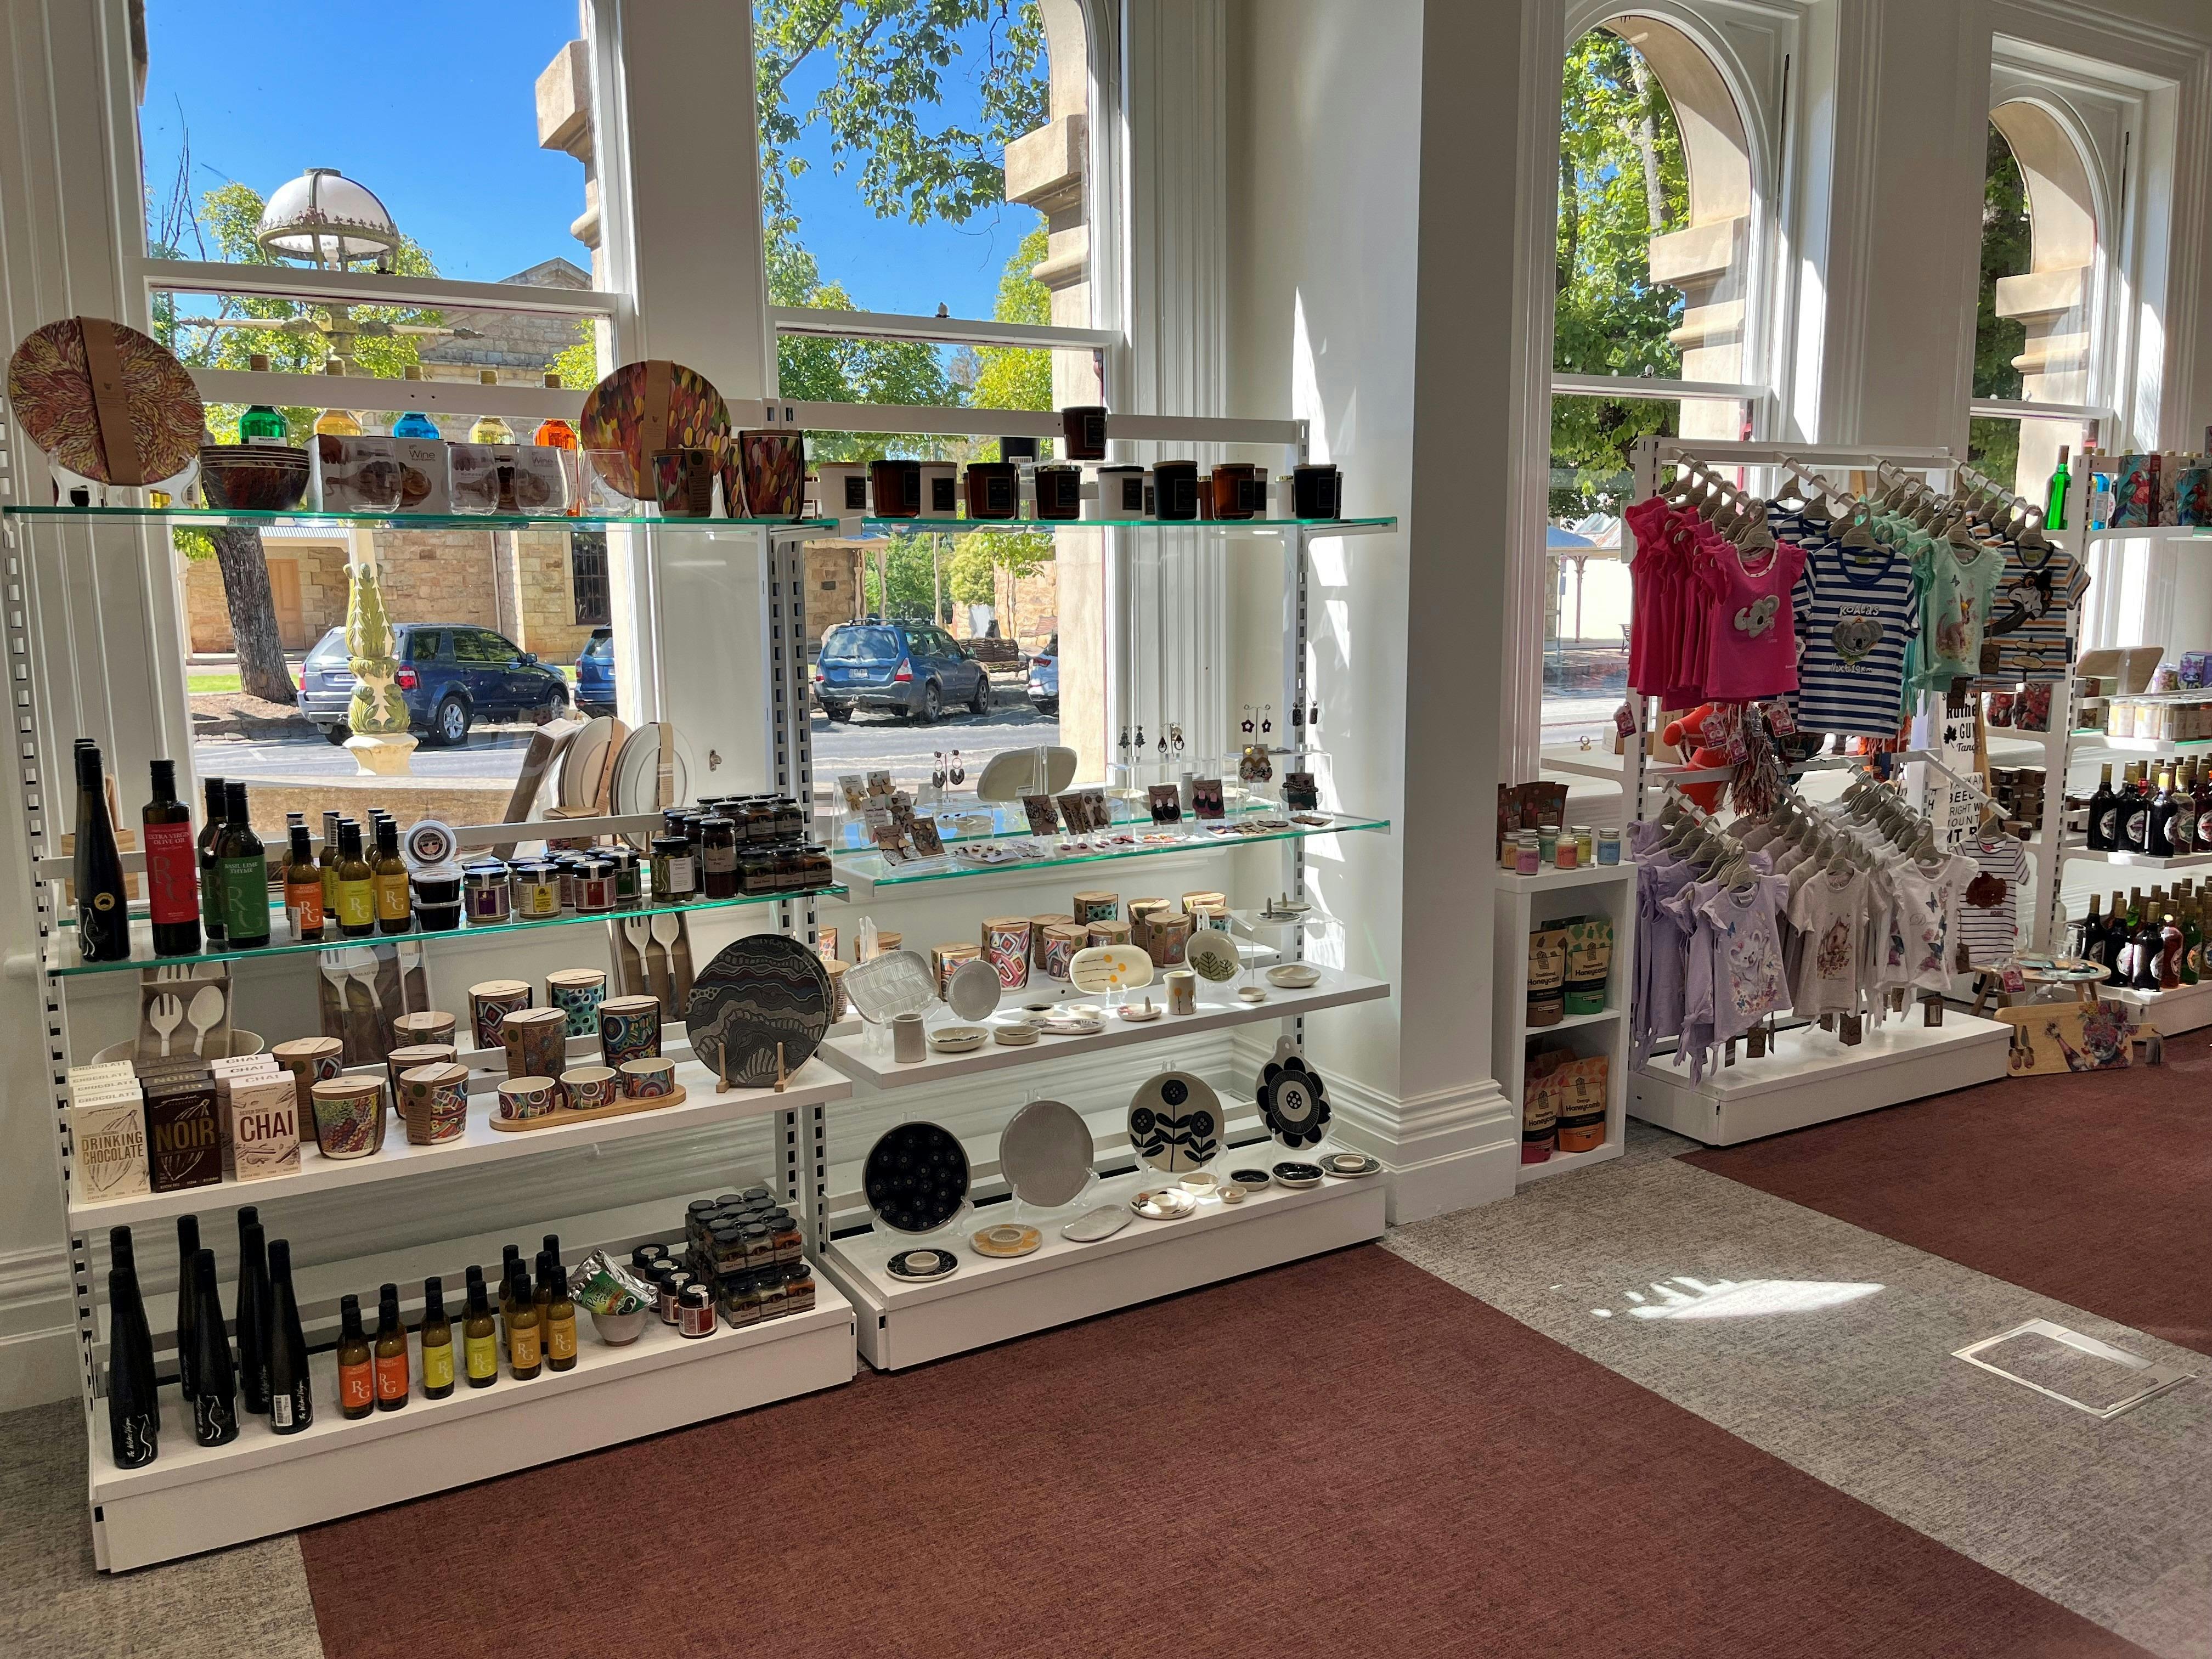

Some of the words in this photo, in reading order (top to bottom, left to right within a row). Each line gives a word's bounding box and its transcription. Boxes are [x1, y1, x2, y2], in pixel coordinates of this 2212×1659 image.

[532, 456, 553, 465] Wine
[1948, 814, 1979, 827] OUNT
[351, 898, 369, 918] RG
[386, 890, 404, 910] RG
[300, 901, 320, 922] RG
[72, 1062, 128, 1071] CHOCOLATE
[73, 1073, 127, 1083] CHOCOLATE
[78, 1080, 135, 1091] CHOCOLATE
[154, 1074, 196, 1084] NOIR
[245, 1074, 279, 1083] CHAI
[78, 1092, 136, 1103] CHOCOLATE
[1566, 1101, 1600, 1111] Honeycomb
[155, 1118, 215, 1151] NOIR
[240, 1110, 294, 1142] CHAI
[82, 1131, 143, 1151] DRINKING
[83, 1144, 144, 1165] CHOCOLATE
[555, 1334, 571, 1351] RG
[517, 1343, 533, 1361] RG
[475, 1353, 492, 1372] RG
[352, 1380, 370, 1398] RG
[379, 1373, 397, 1393] RG
